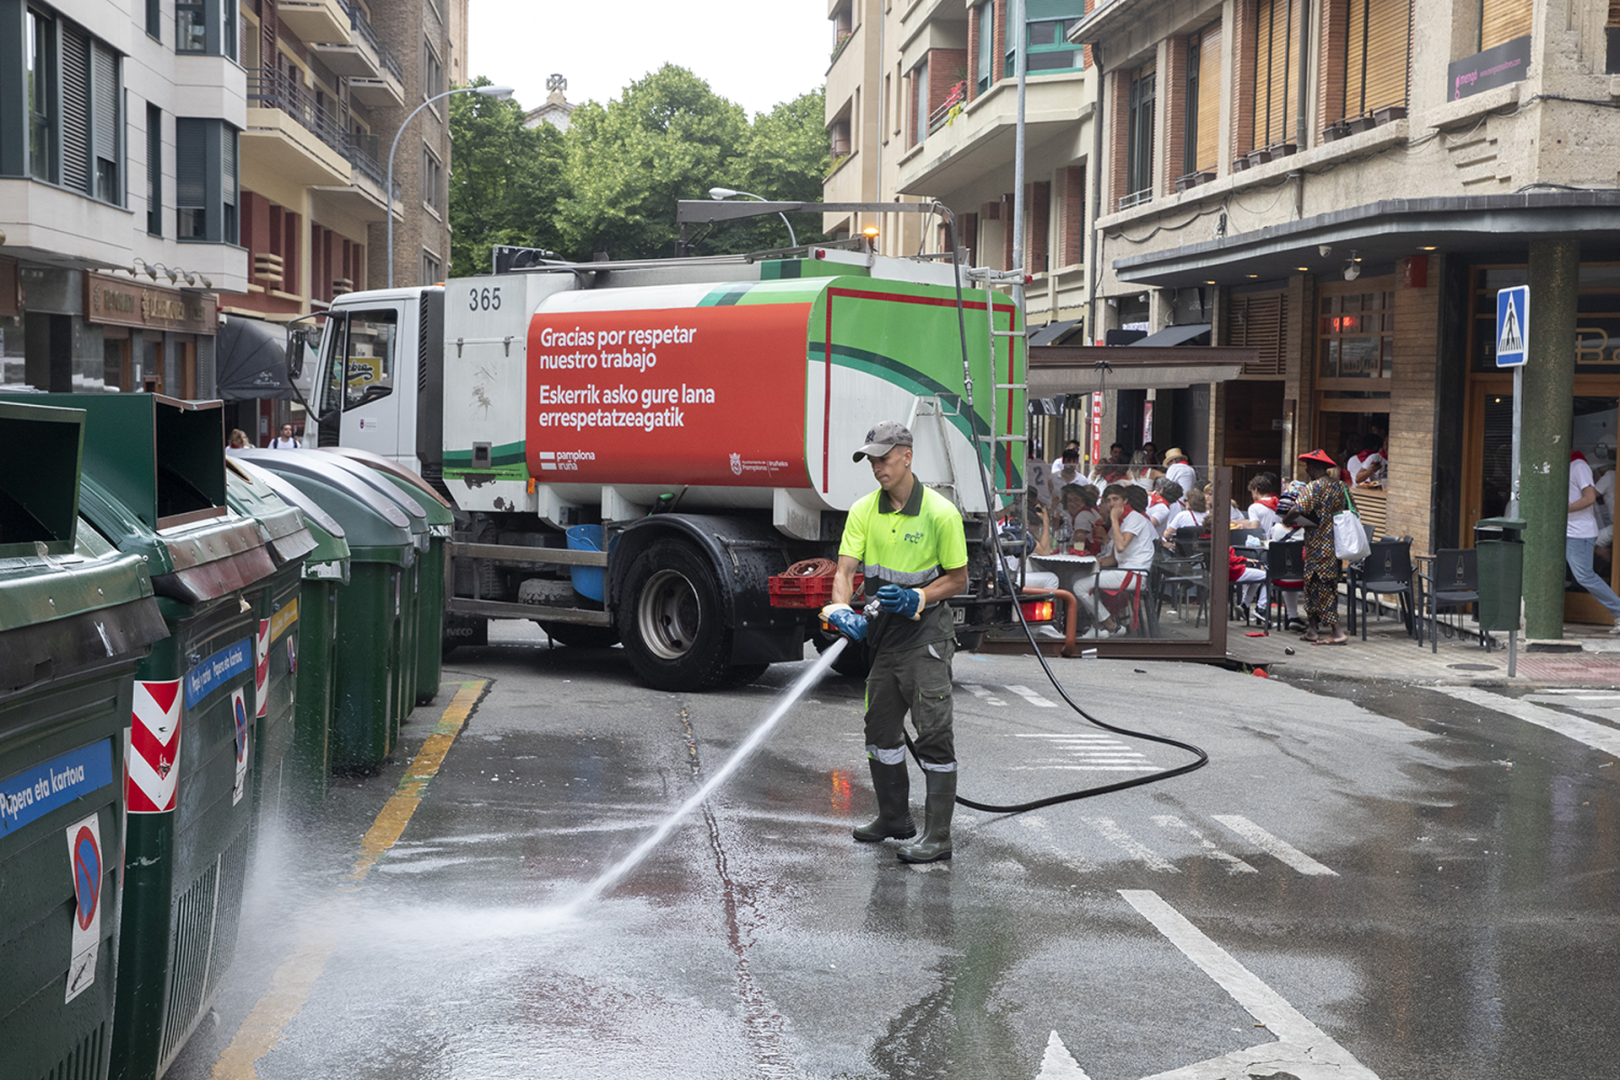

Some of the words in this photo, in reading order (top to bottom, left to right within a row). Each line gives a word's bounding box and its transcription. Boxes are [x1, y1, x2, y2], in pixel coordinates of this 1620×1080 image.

[469, 287, 501, 311] 365
[540, 326, 595, 347] Gracias
[598, 330, 626, 350] por
[628, 325, 697, 349] respetar
[540, 351, 598, 369] nuestro
[600, 347, 657, 373] trabajo
[539, 384, 600, 404] Eskerrik
[603, 384, 638, 404] asko
[641, 388, 679, 409] gure
[682, 383, 715, 404] lana
[539, 406, 684, 432] errespetatzeagatik
[556, 449, 596, 463] pamplona
[557, 460, 579, 470] iruña
[1033, 466, 1044, 485] 2
[447, 628, 473, 637] IVECO
[34, 777, 50, 801] eta
[50, 765, 85, 793] kartoia
